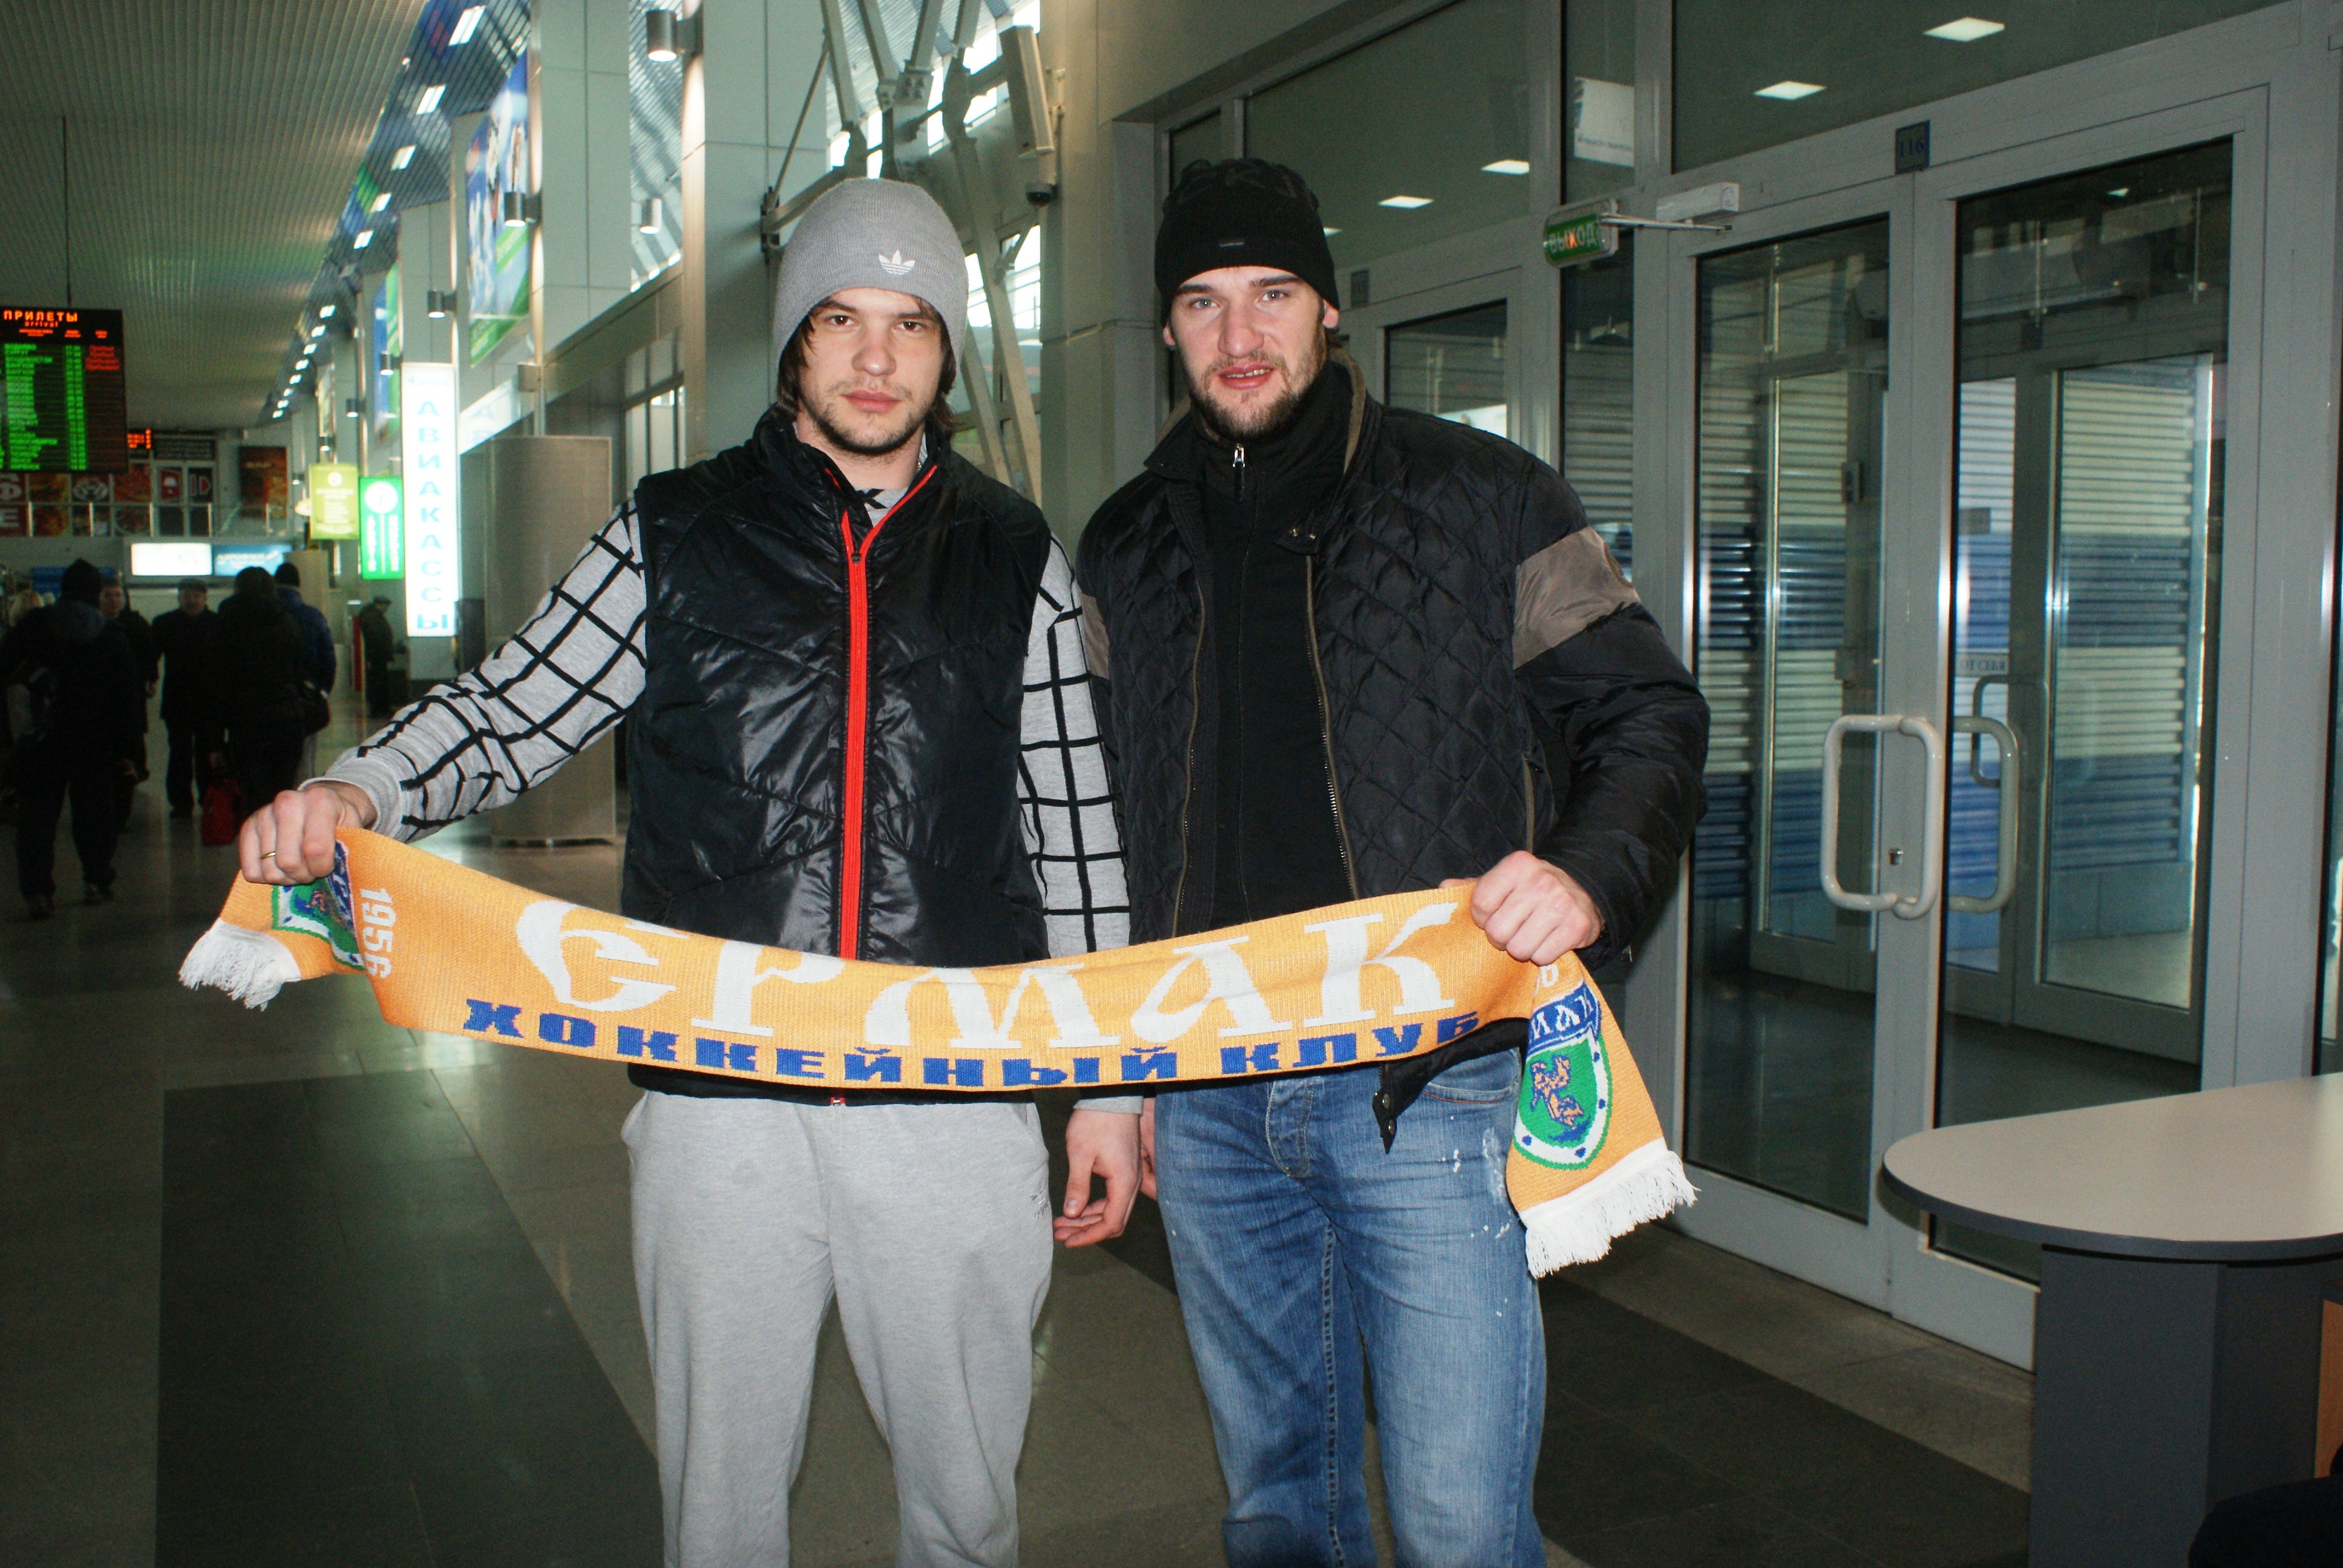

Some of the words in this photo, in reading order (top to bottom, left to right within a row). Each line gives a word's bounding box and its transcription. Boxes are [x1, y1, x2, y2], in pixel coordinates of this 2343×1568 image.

[1899, 137, 1924, 158] 116
[1547, 222, 1598, 254] ВЫХОД
[3, 309, 78, 322] ПРИЛЕТЫ
[416, 401, 448, 630] АВИАКАССЫ
[359, 887, 397, 979] 1956
[462, 998, 1178, 1087] ХОККЕЙНЫЙ
[1220, 1011, 1480, 1075] КЛУБ
